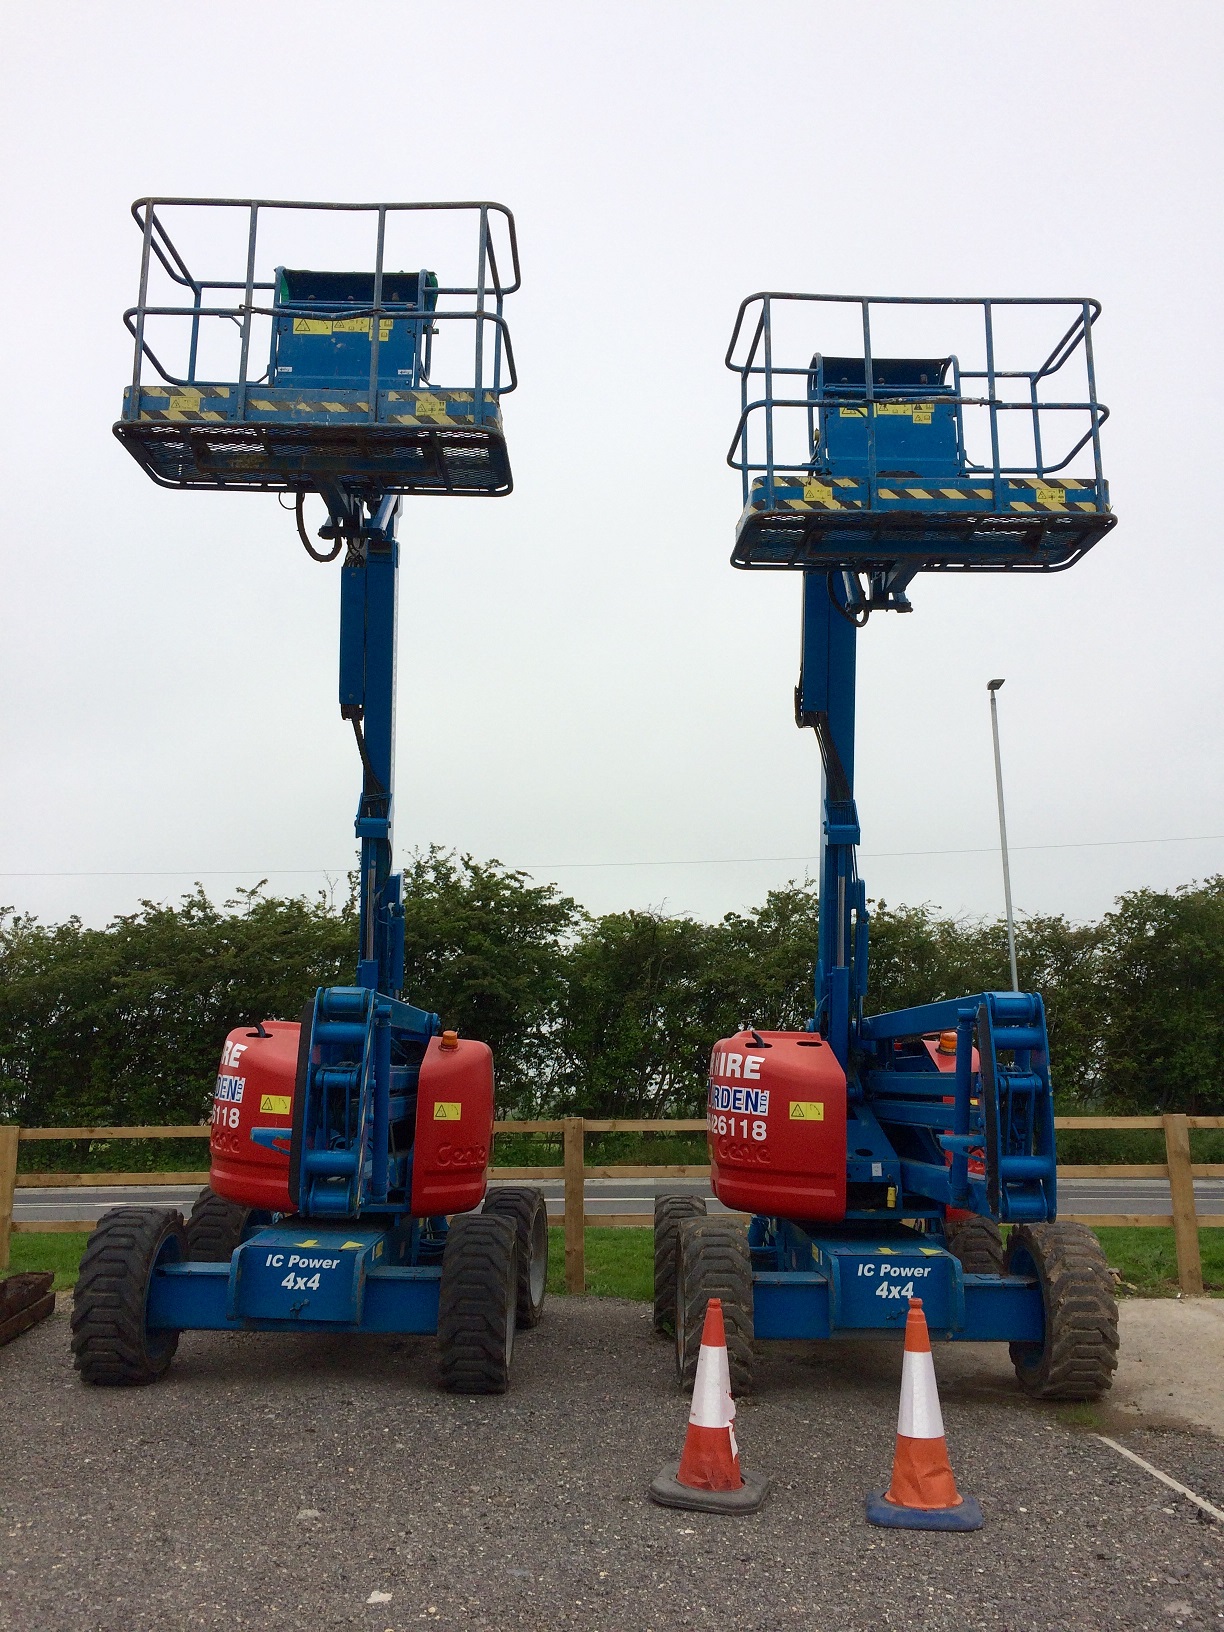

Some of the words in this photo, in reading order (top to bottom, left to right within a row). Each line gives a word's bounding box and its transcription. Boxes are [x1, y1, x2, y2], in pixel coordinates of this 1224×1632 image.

[220, 1040, 248, 1068] RE
[711, 1084, 760, 1114] RDEN
[212, 1104, 240, 1128] 6118
[709, 1114, 767, 1141] 26118
[265, 1254, 284, 1267] IC
[288, 1254, 340, 1269] Power
[857, 1263, 875, 1277] IC
[879, 1264, 931, 1277] Power
[281, 1272, 320, 1290] 4x4
[875, 1281, 914, 1299] 4x4
